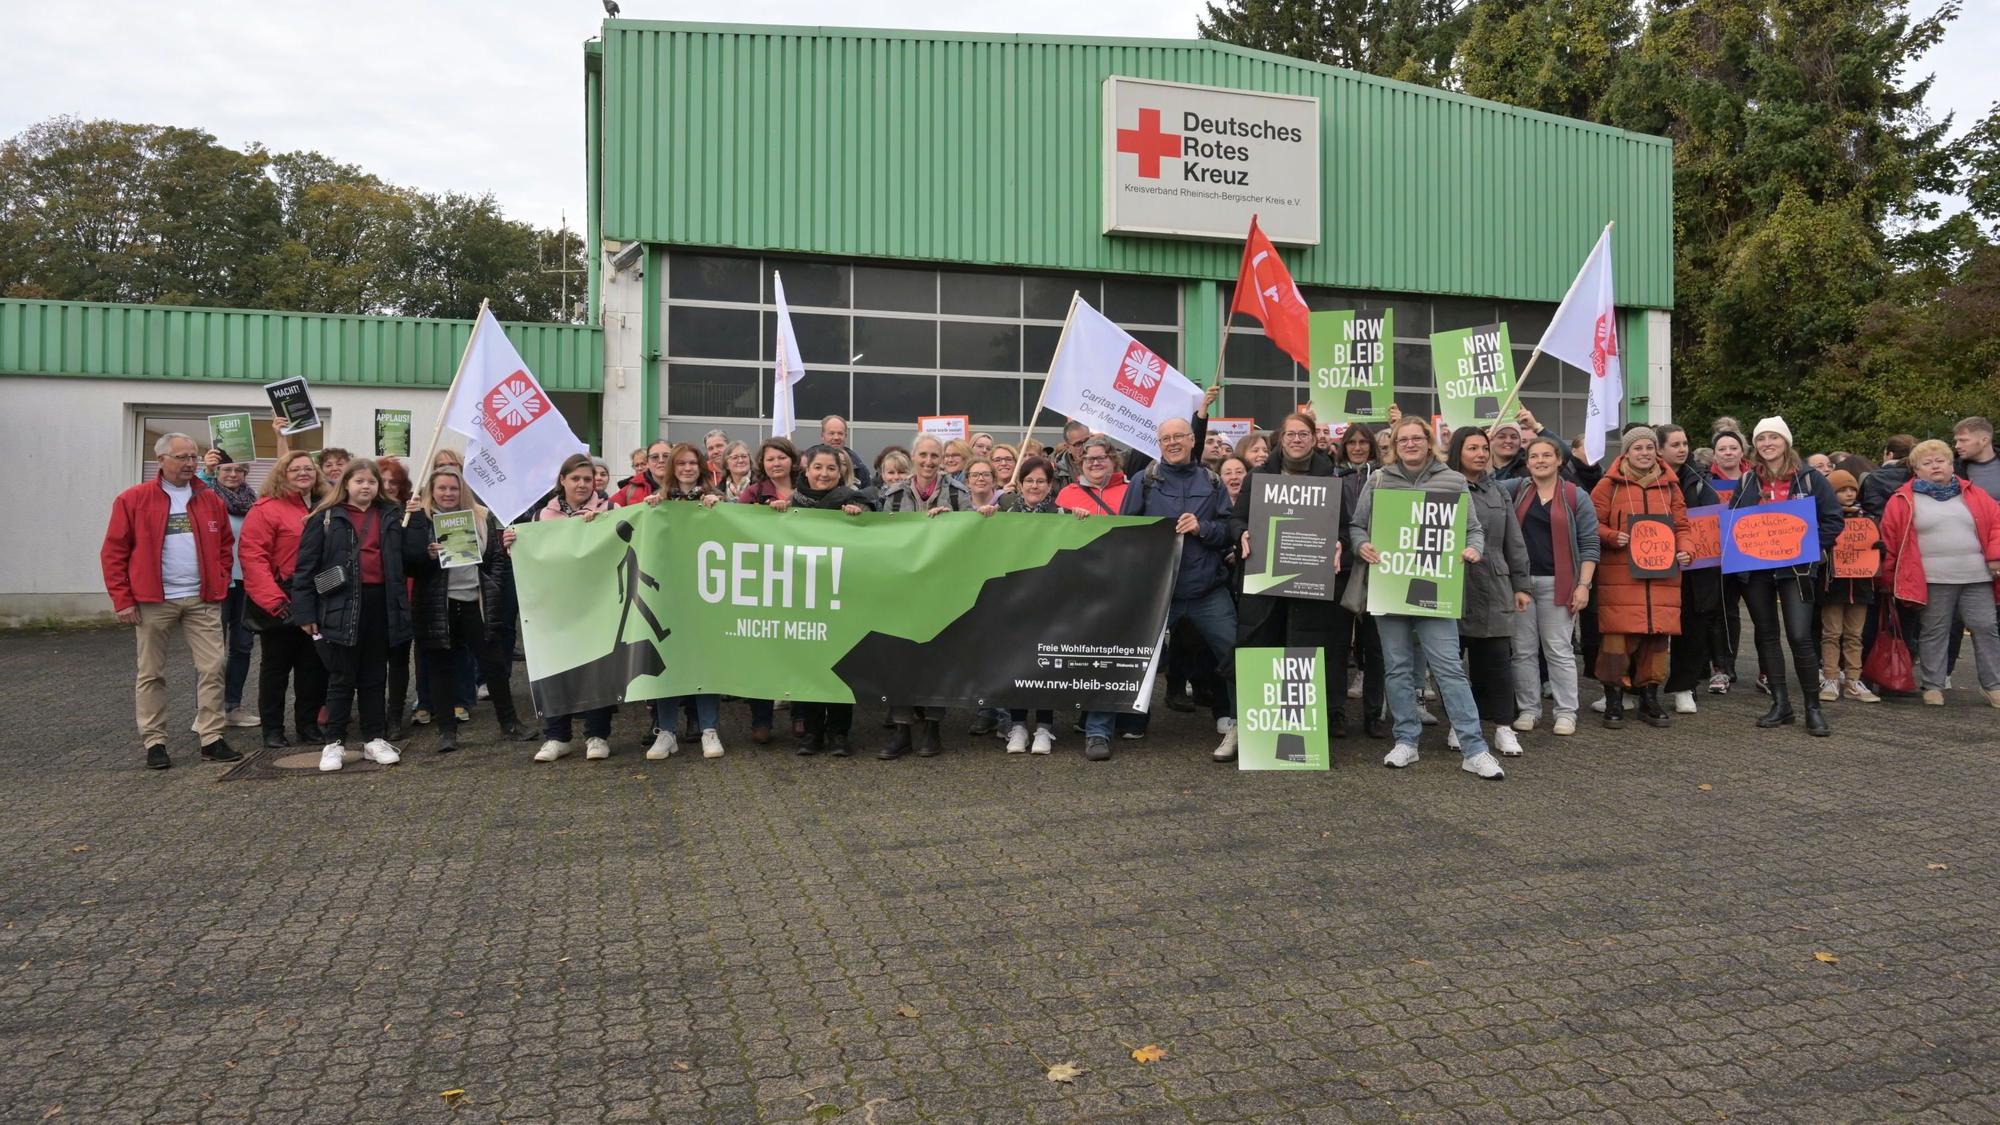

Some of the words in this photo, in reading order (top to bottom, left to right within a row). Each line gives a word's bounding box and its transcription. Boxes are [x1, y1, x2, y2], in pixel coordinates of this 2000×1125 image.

[1183, 111, 1302, 143] Deutsches
[1183, 136, 1249, 161] Rotes
[1183, 161, 1249, 186] Kreuz
[1124, 183, 1178, 196] Kreisverband
[1180, 188, 1264, 203] Rheinisch-Bergischer
[1265, 195, 1285, 205] Kreis
[1287, 198, 1302, 207] e.V.
[1343, 318, 1384, 341] NRW
[1334, 342, 1384, 365] BLEIB
[1462, 332, 1501, 356] NRW
[1318, 365, 1384, 388] SOZIAL!
[1457, 353, 1504, 377] BLEIB
[273, 384, 300, 398] MACHT!
[1115, 382, 1149, 406] caritas
[1445, 372, 1508, 399] SOZIAL!
[376, 413, 410, 423] APPLAUS!
[1080, 402, 1099, 416] Der
[1098, 411, 1136, 434] Mensch
[1081, 388, 1117, 411] Caritas
[1117, 405, 1158, 432] RheinBe
[219, 419, 241, 430] GEHT!
[484, 412, 505, 442] aritas
[480, 448, 507, 483] inBerg
[1264, 483, 1327, 507] MACHT!
[440, 516, 468, 529] IMMER!
[1410, 501, 1458, 526] NRW
[1399, 526, 1455, 552] BLEIB
[697, 540, 844, 610] GEHT!
[1379, 551, 1454, 578] SOZIAL!
[725, 618, 780, 639] ...NICHT
[784, 620, 827, 641] MEHR
[1037, 643, 1059, 652] Freie
[1060, 644, 1135, 656] Wohlfahrtspflege
[1272, 657, 1316, 680] NRW
[1014, 678, 1139, 692] www.nrw-bleib-sozial
[1263, 683, 1317, 706] BLEIB
[1246, 708, 1318, 731] SOZIAL!
